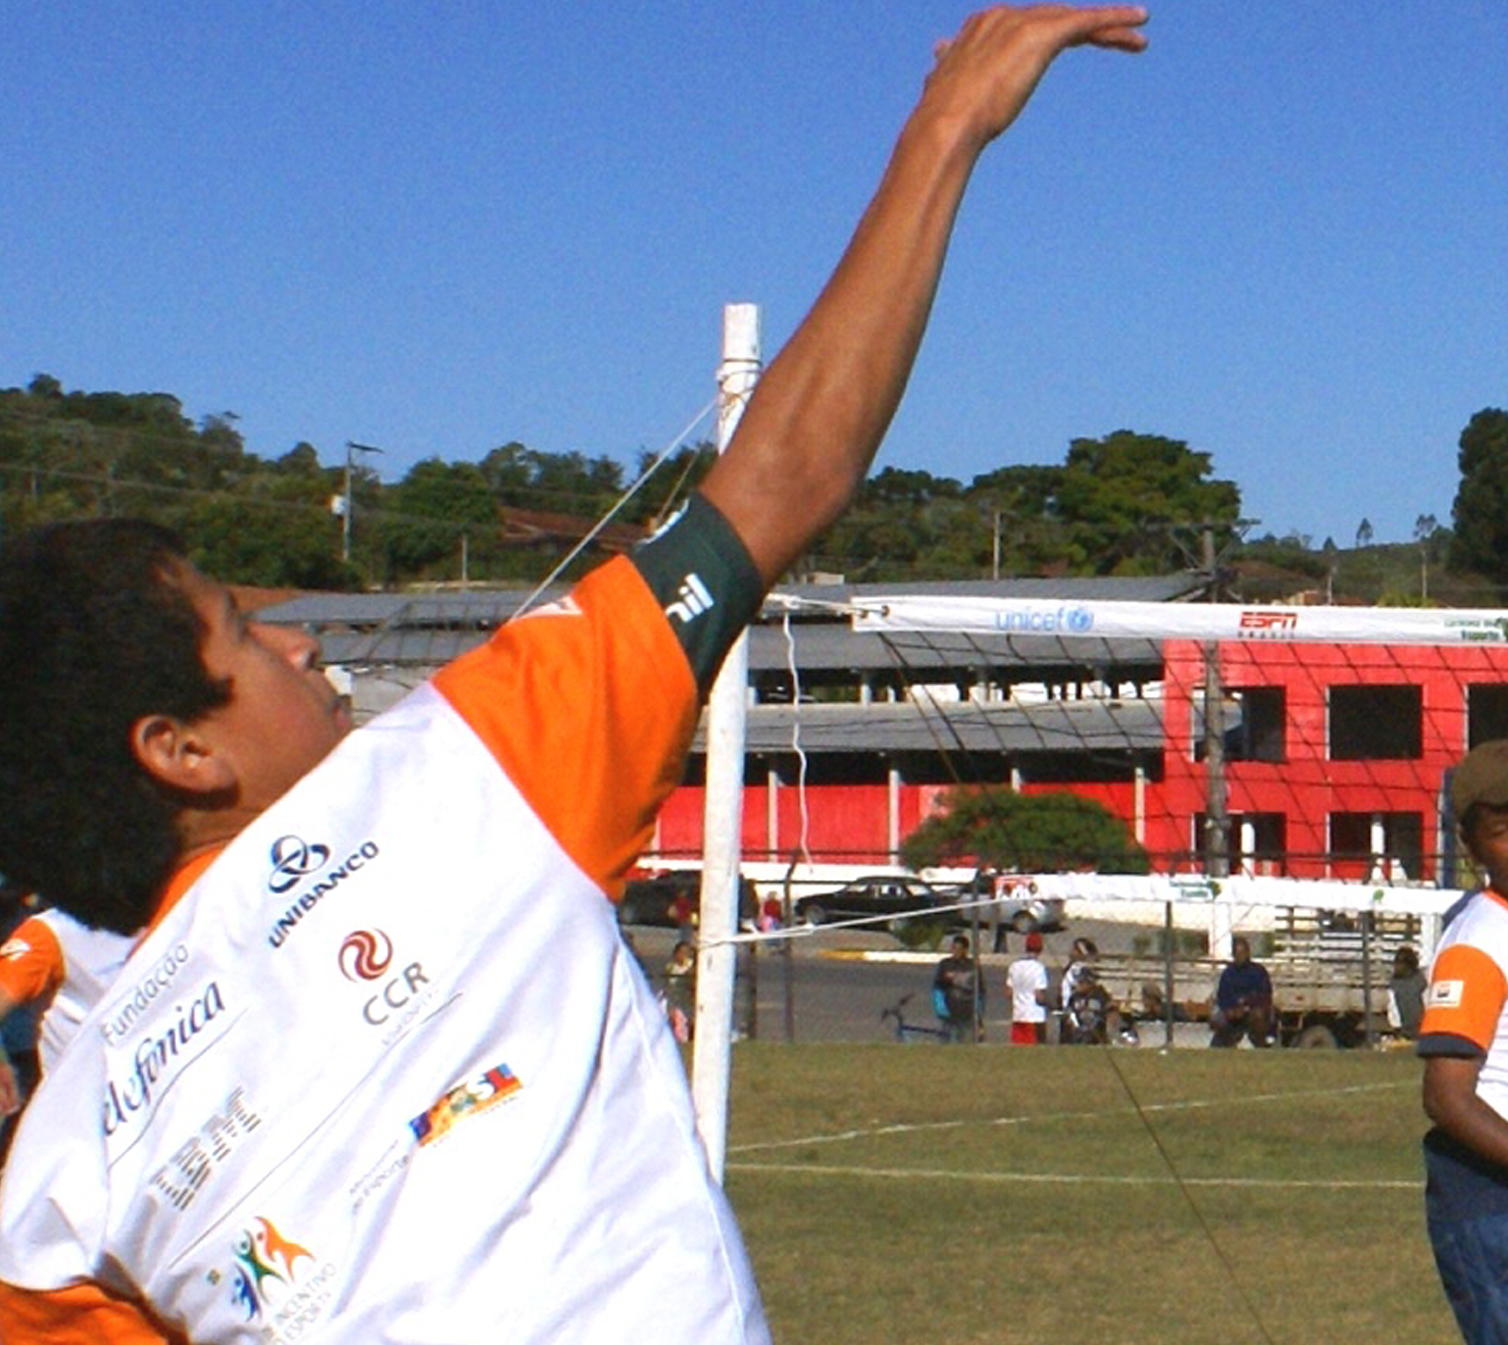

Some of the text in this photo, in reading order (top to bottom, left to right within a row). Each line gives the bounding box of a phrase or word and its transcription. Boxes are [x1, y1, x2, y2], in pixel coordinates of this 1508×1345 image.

[996, 606, 1063, 631] unicef
[1240, 611, 1297, 629] ESPN
[268, 841, 379, 948] UNIBANCO
[101, 944, 190, 1045] Fundação
[363, 962, 429, 1025] CCR
[150, 1086, 261, 1211] IBM
